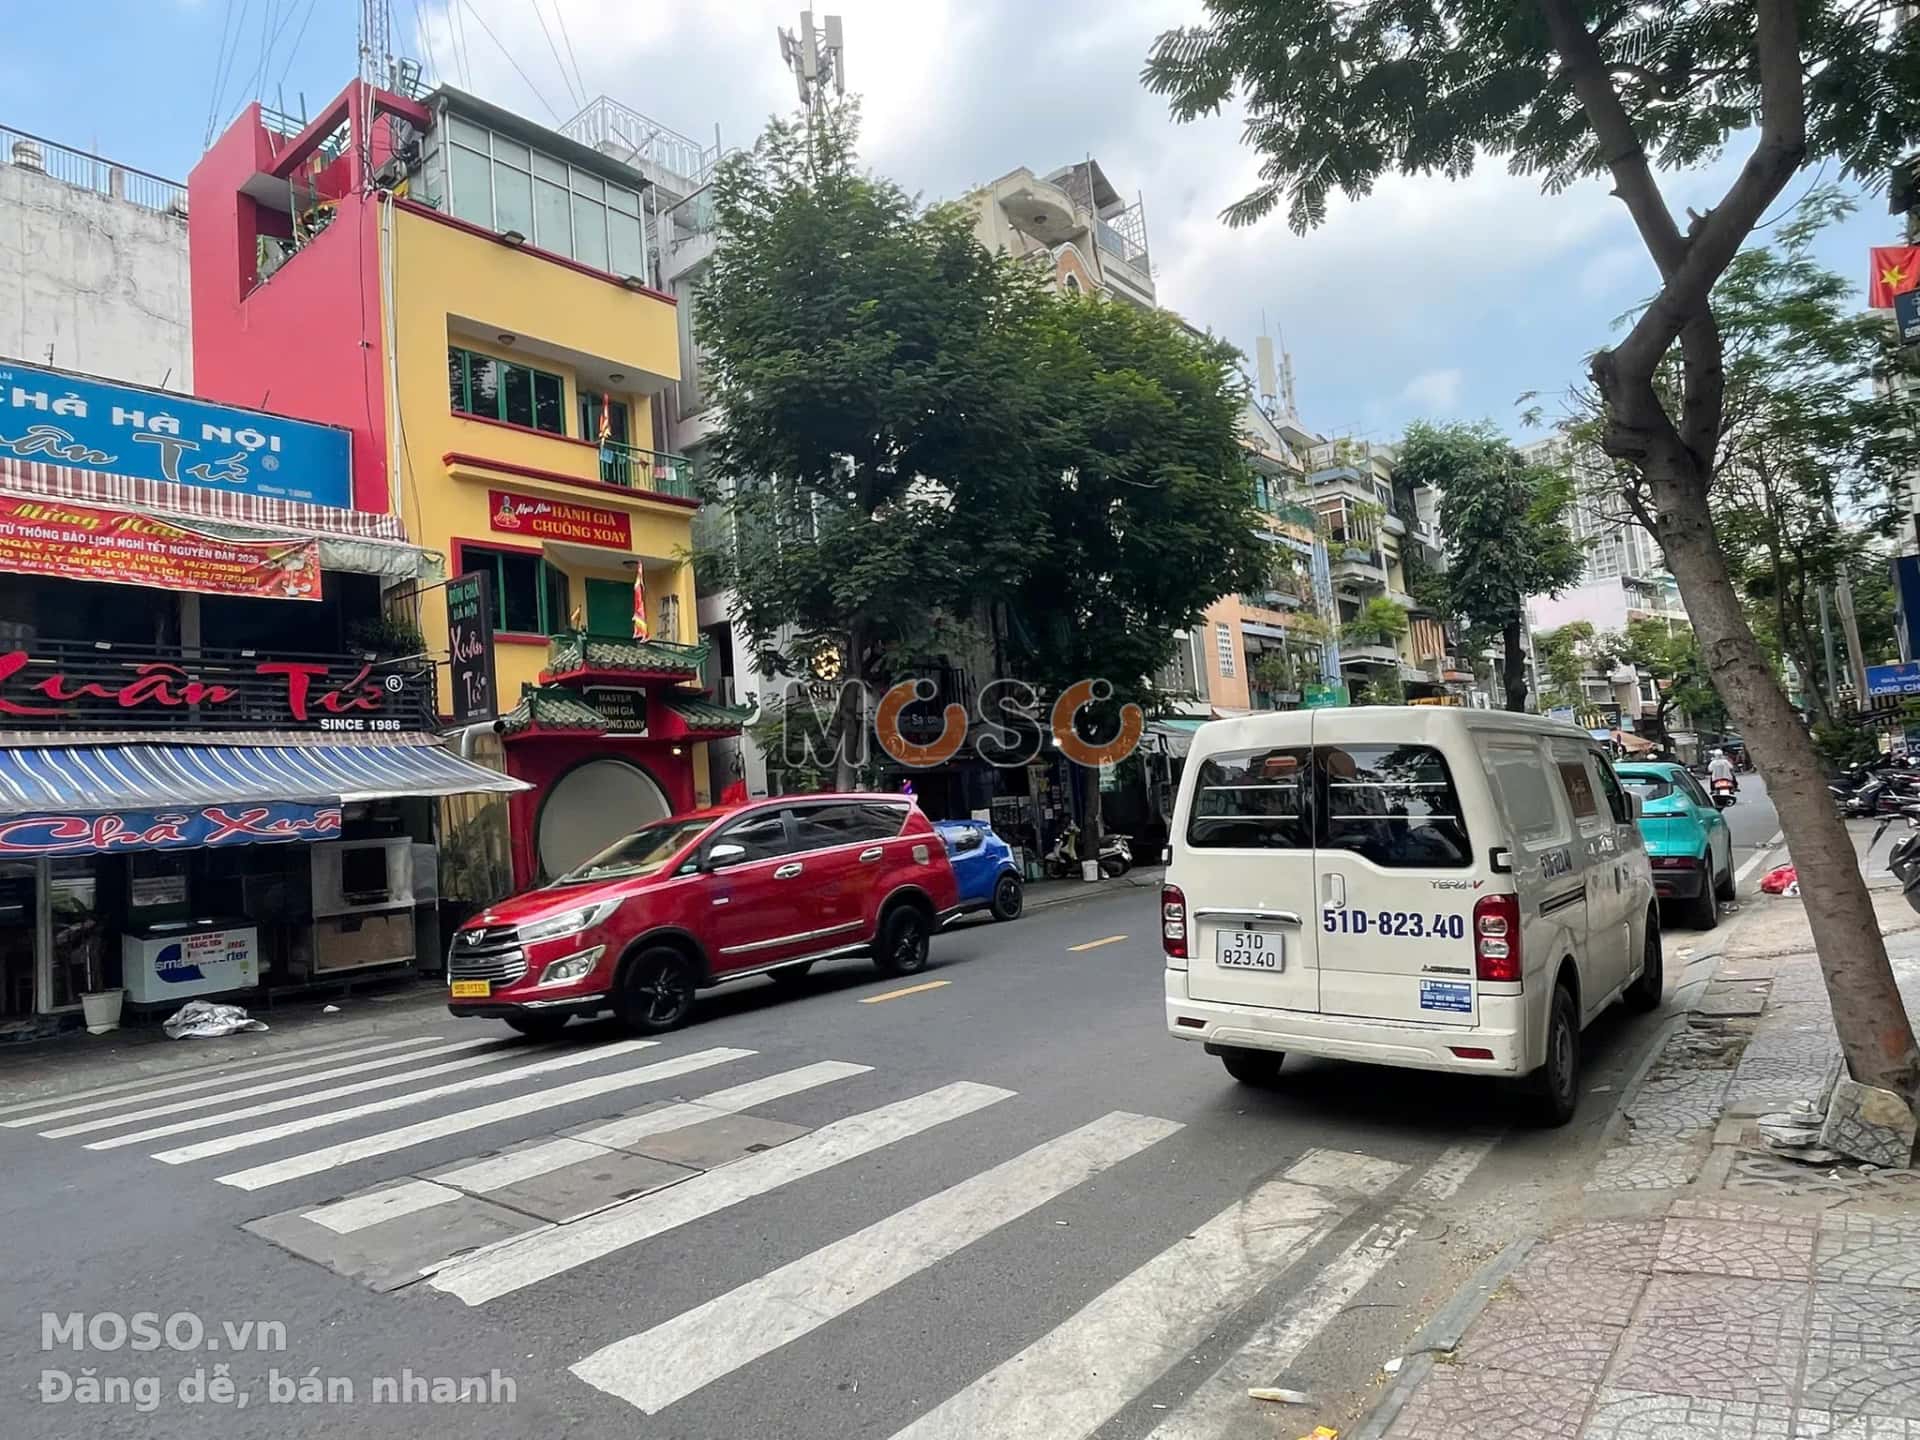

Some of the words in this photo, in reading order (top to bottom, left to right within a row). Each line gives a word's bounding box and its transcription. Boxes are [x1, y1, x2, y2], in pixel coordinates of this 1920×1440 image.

[112, 407, 180, 435] HÀ
[202, 423, 281, 452] NỘI
[17, 525, 59, 540] THÔNG
[88, 534, 114, 547] LỊCH
[533, 519, 591, 538] CHUÔNG
[593, 528, 626, 543] XOAY
[450, 624, 483, 668] Xuân
[256, 662, 383, 720] Tứ
[599, 693, 633, 703] MASTER
[1869, 685, 1900, 695] LONG
[320, 718, 364, 731] SINCE
[370, 719, 400, 731] 1986
[623, 719, 644, 729] XOAY
[1323, 909, 1464, 940] 51D-823.40
[1235, 933, 1263, 950] 51D
[1223, 950, 1275, 968] 823.40
